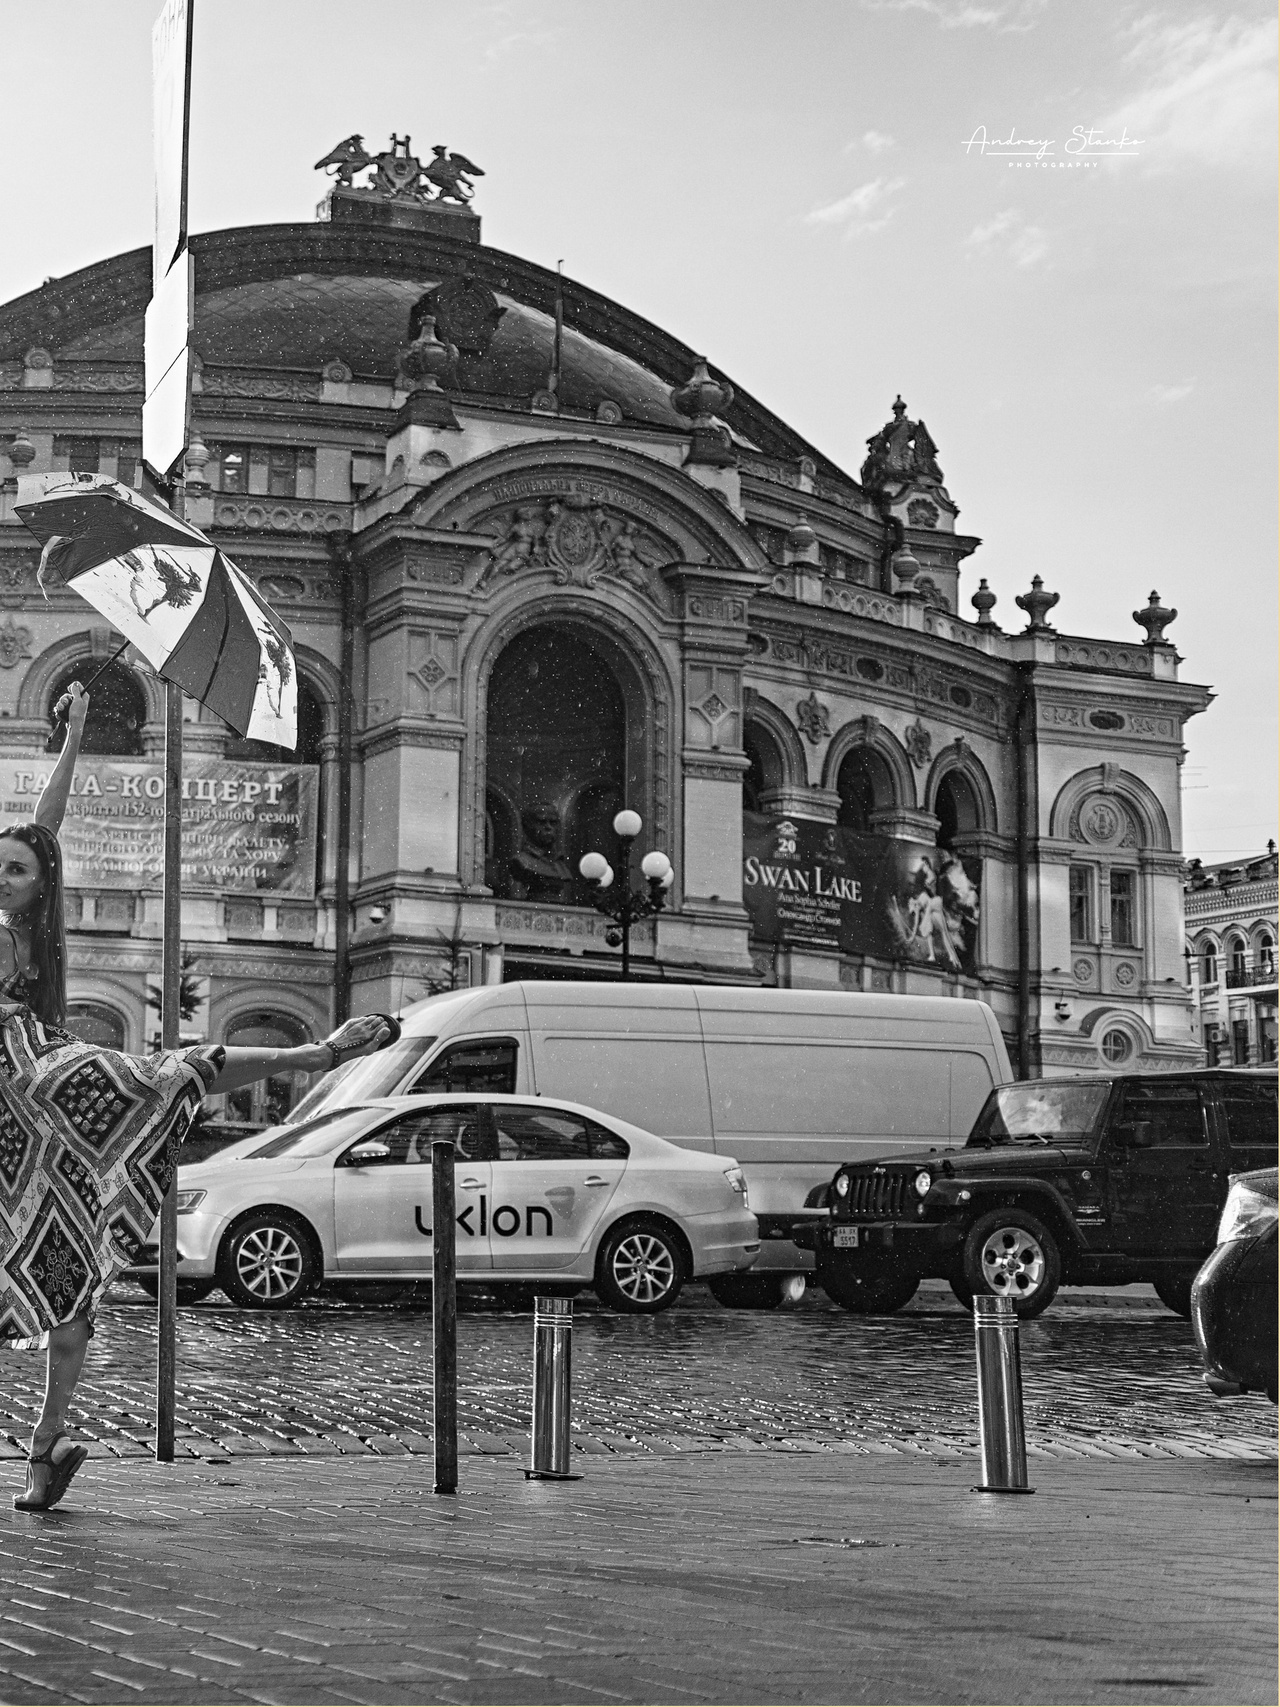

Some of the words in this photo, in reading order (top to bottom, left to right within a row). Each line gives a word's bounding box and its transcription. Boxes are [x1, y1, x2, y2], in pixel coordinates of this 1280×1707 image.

[181, 808, 255, 823] атрального
[259, 812, 300, 828] сезону
[778, 837, 797, 854] 20
[414, 1194, 553, 1237] uklon
